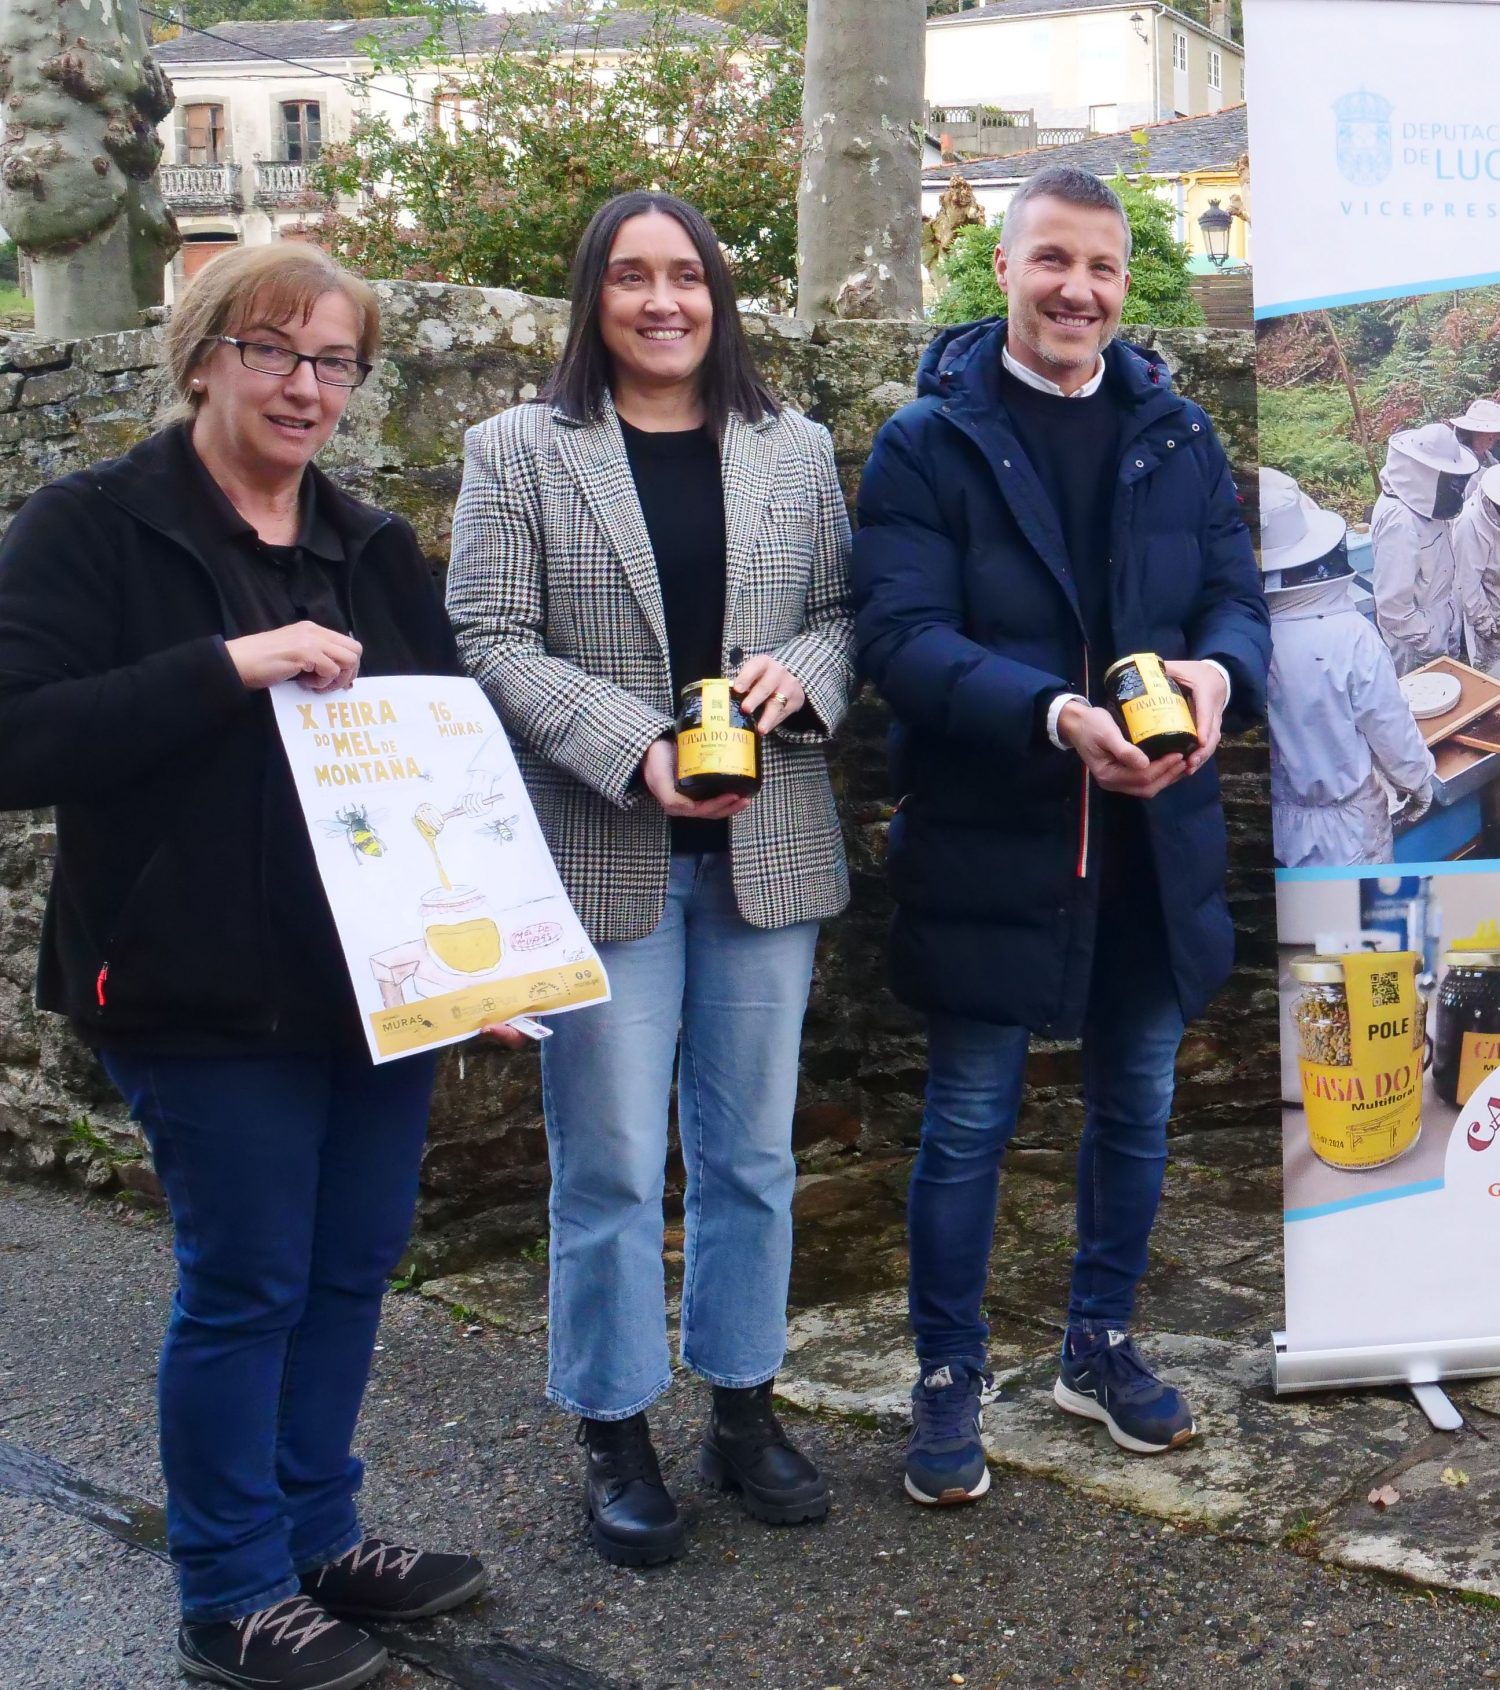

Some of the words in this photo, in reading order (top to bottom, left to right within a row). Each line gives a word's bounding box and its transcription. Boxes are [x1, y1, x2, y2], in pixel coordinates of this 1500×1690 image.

[1402, 147, 1430, 167] DE
[296, 703, 319, 730] X
[325, 699, 398, 729] FEIRA
[428, 701, 452, 722] 16
[437, 721, 484, 737] MURAS
[313, 733, 331, 747] DO
[330, 730, 381, 758] MEL
[380, 740, 398, 754] DE
[313, 754, 422, 787] MONTAÑA
[382, 1013, 424, 1032] MURAS
[1367, 1017, 1409, 1041] POLE
[1303, 1071, 1365, 1102] CASA
[1375, 1065, 1411, 1098] DO
[1351, 1084, 1415, 1112] Multifloral
